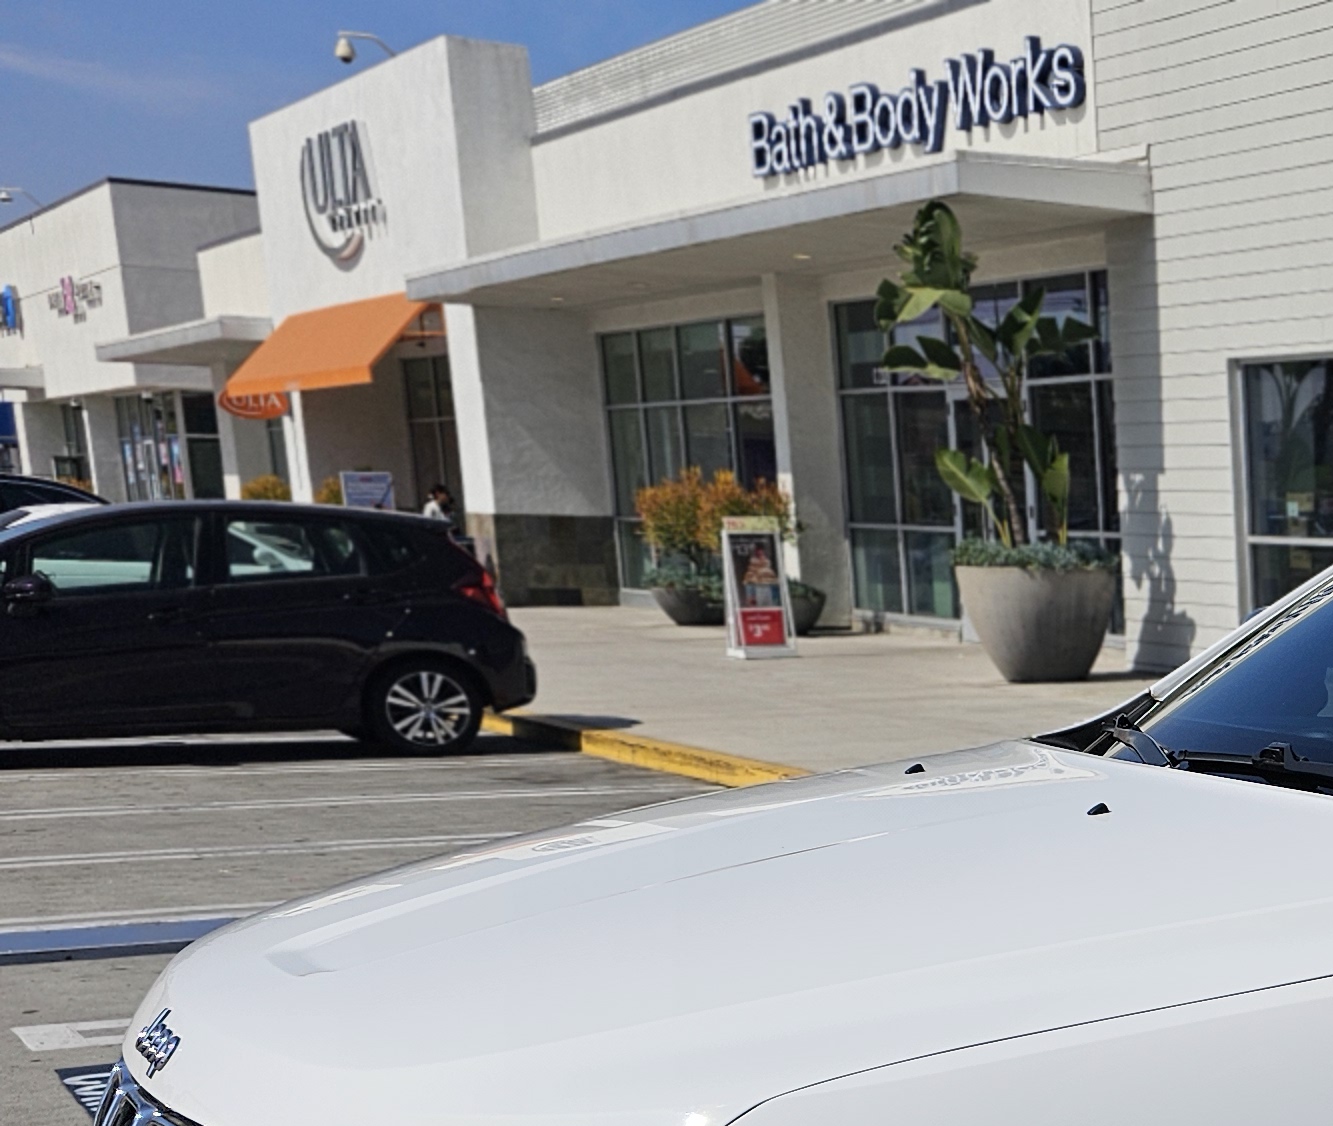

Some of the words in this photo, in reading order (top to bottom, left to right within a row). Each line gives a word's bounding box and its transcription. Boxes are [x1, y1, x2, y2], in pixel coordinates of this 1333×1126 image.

[749, 98, 828, 177] Bath
[850, 67, 949, 154] Body
[944, 35, 1087, 131] Works
[305, 119, 373, 215] ULTA
[135, 1008, 181, 1079] Jeep
